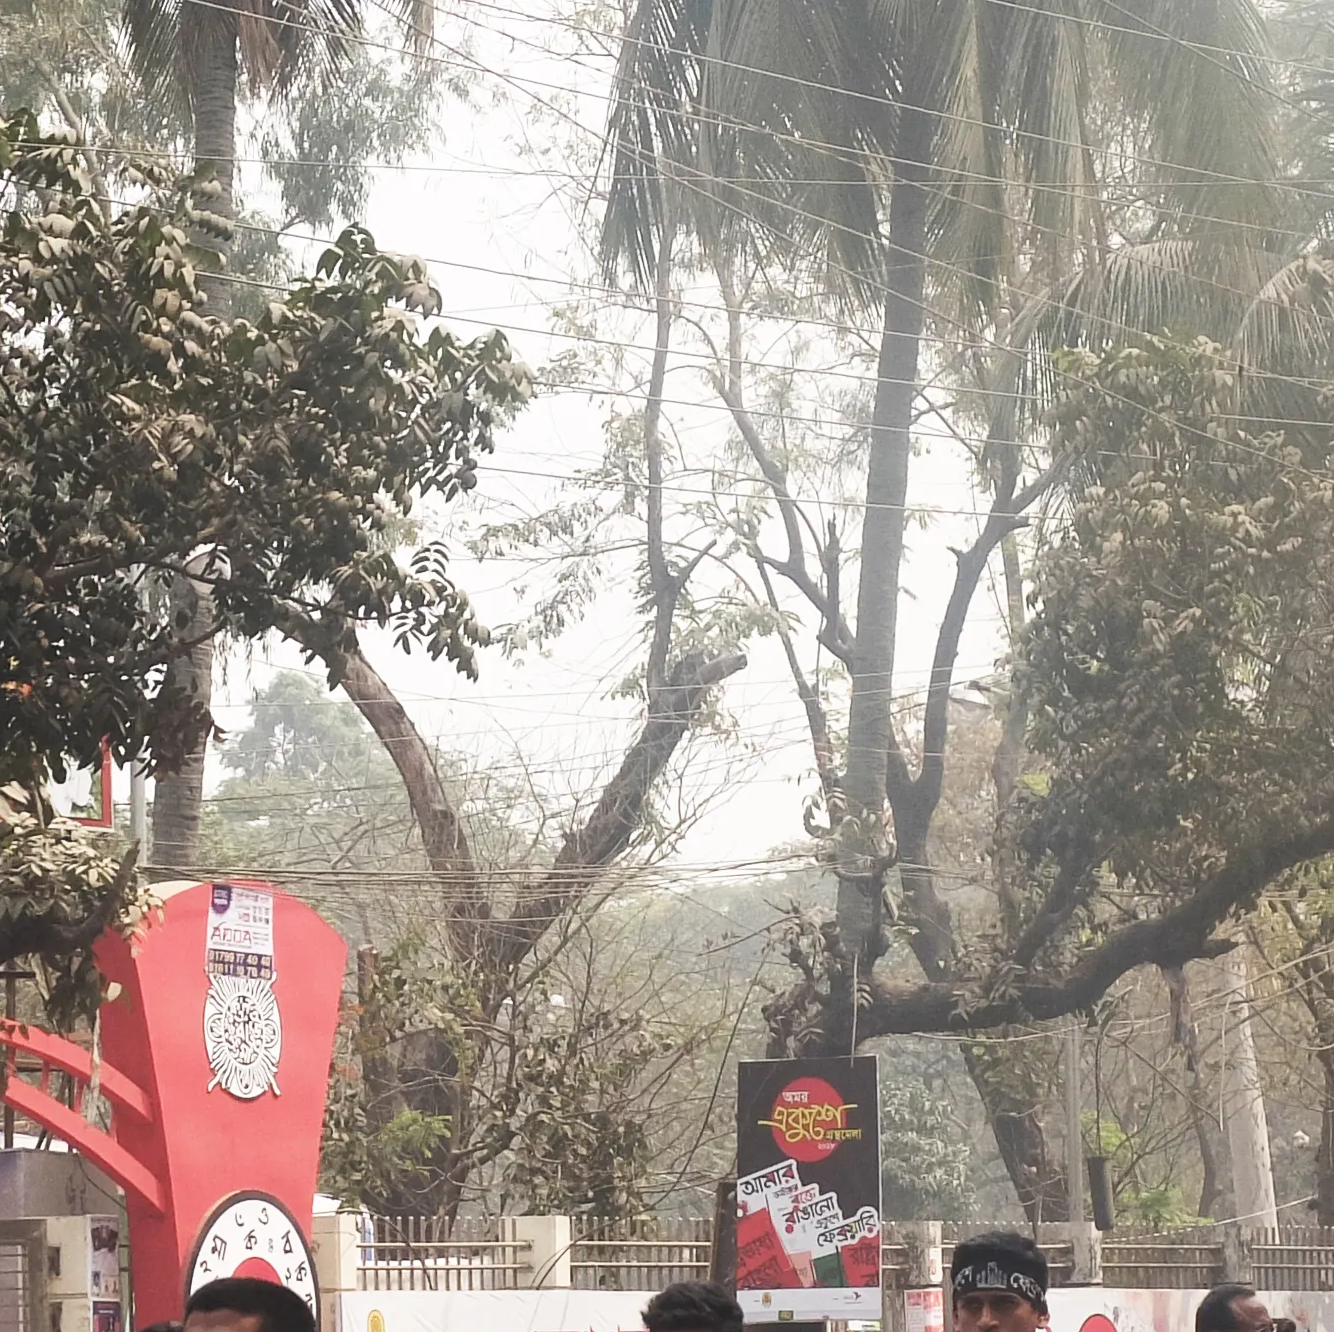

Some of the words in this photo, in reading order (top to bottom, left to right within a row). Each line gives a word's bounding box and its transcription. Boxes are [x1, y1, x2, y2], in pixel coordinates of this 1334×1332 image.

[782, 1091, 809, 1103] অমর
[758, 1102, 858, 1142] একুশে
[740, 1164, 795, 1196] আমার
[782, 1196, 835, 1234] রাঙানো
